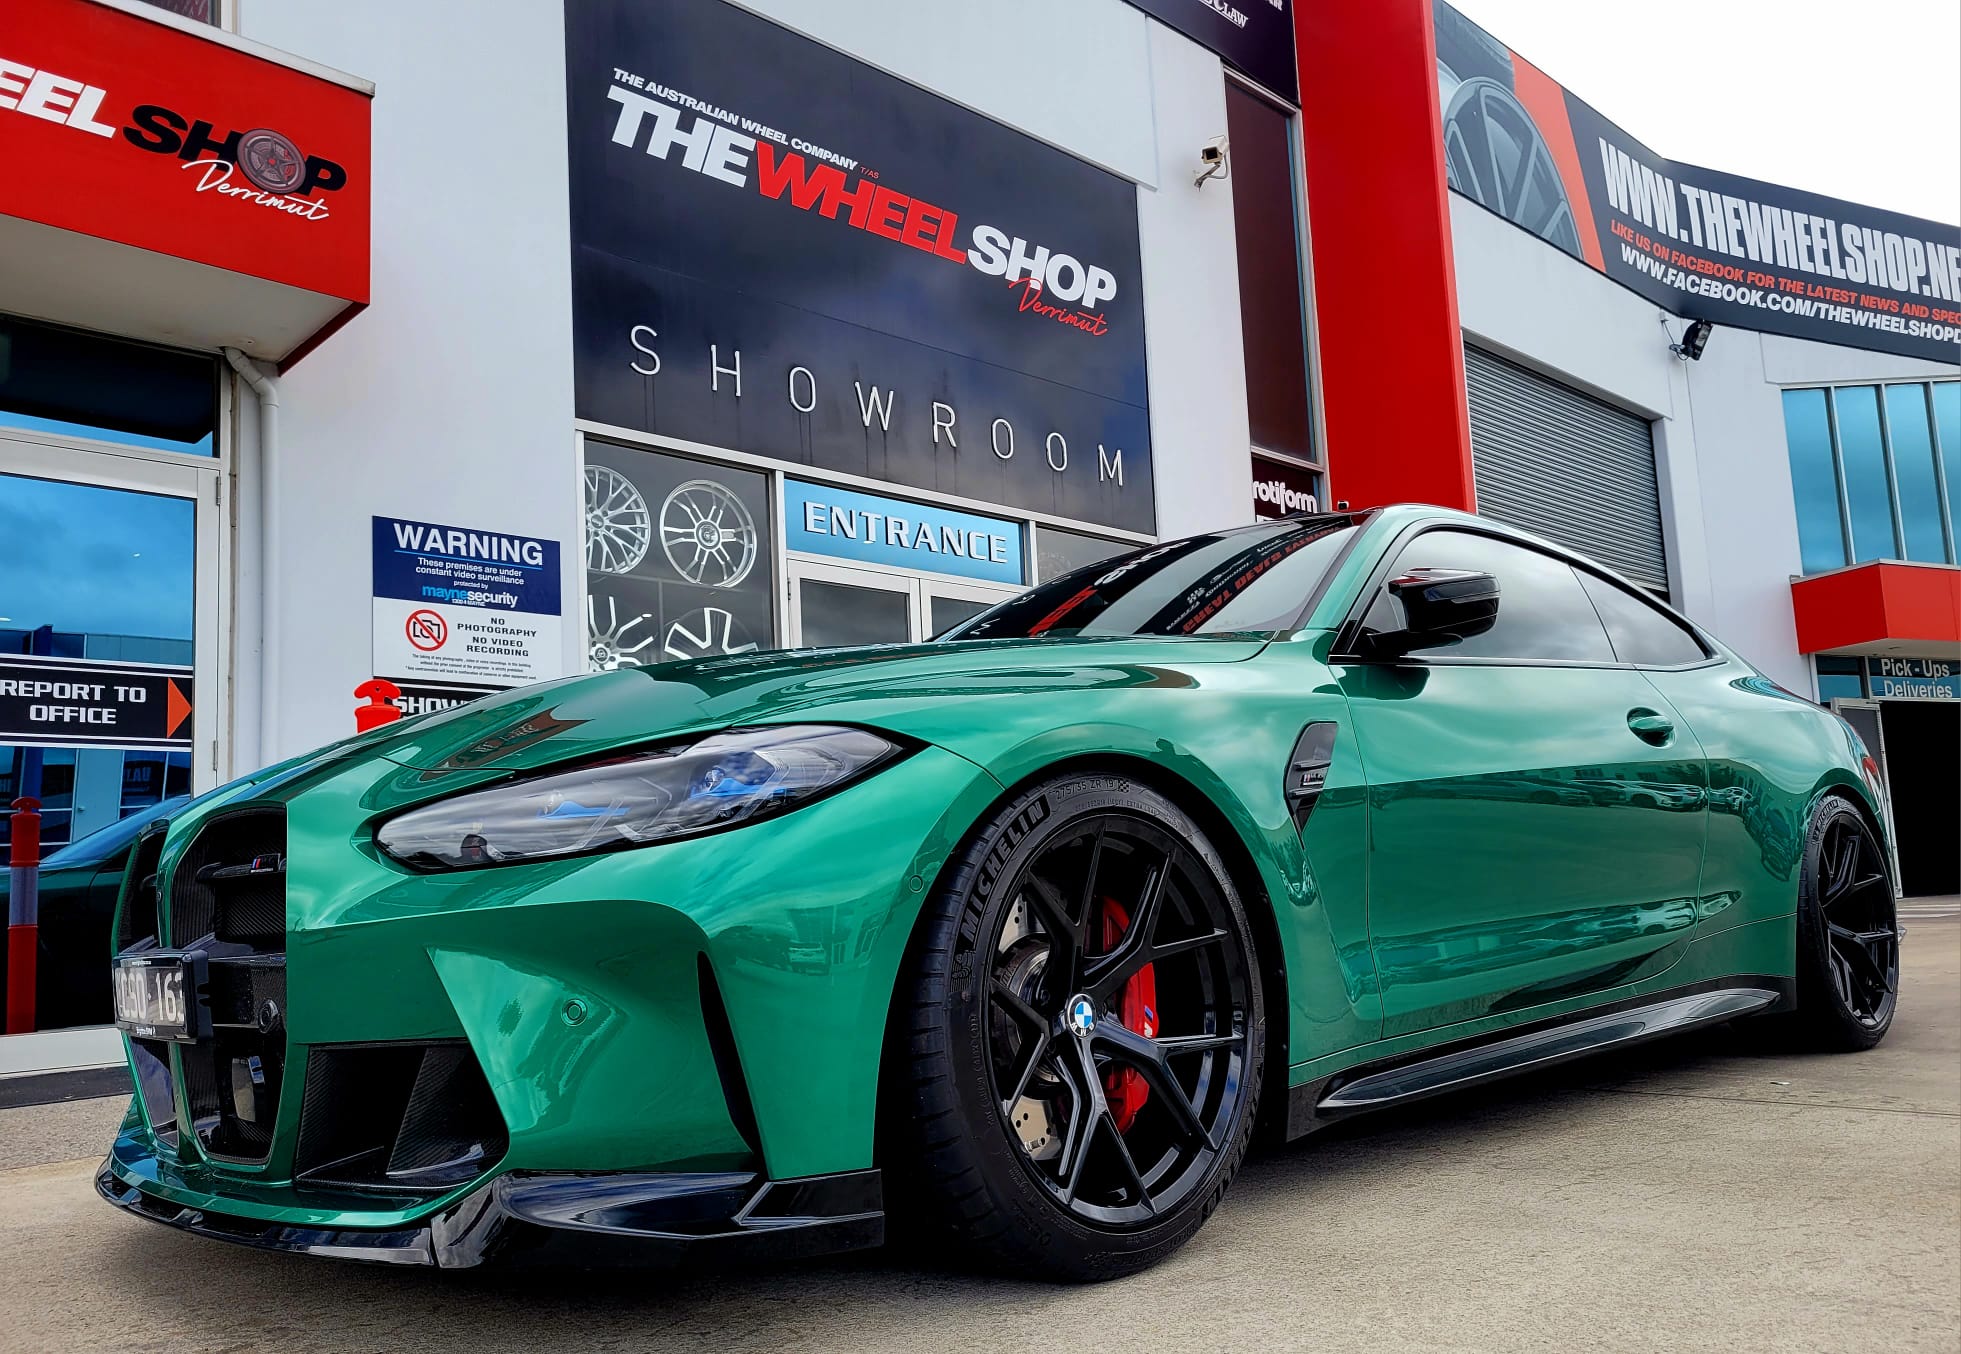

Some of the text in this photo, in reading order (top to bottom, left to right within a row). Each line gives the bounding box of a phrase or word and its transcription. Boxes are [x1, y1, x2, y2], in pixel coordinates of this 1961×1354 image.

[613, 67, 880, 179] THE AUSTRALIAN WHEEL COMPANY T/AS
[182, 160, 329, 220] Derrimut
[607, 84, 1117, 308] THE WHEEL SHOP
[1611, 219, 1634, 244] LIKE
[1635, 232, 1652, 252] US
[1653, 241, 1669, 260] ON
[1671, 251, 1745, 283] FACEBOOK
[1747, 270, 1776, 288] FOR
[1778, 278, 1804, 295] THE
[1807, 283, 1858, 304] LATEST
[1860, 294, 1900, 313] NEWS
[1901, 302, 1930, 318] AND
[1009, 277, 1108, 336] Derrimut
[630, 325, 1123, 487] SHOWROOM
[1253, 481, 1318, 514] rotiform
[393, 523, 543, 566] WARNING
[803, 501, 1007, 565] ENTRANCE
[416, 566, 524, 585] constant video surveillance
[418, 557, 522, 577] These premises are under
[422, 585, 518, 608] maynesecurity
[457, 623, 537, 638] PHOTOGRAPHY
[490, 617, 505, 625] NO
[466, 645, 529, 657] RECORDING
[472, 636, 523, 648] NO VIDEO
[1881, 659, 1912, 677] Pick
[1922, 659, 1950, 680] Ups
[0, 680, 146, 703] REPORT TO
[1883, 680, 1953, 698] Deliveries
[29, 704, 117, 724] OFFICE
[392, 696, 469, 714] SHOW
[961, 800, 1045, 942] MICHELIN
